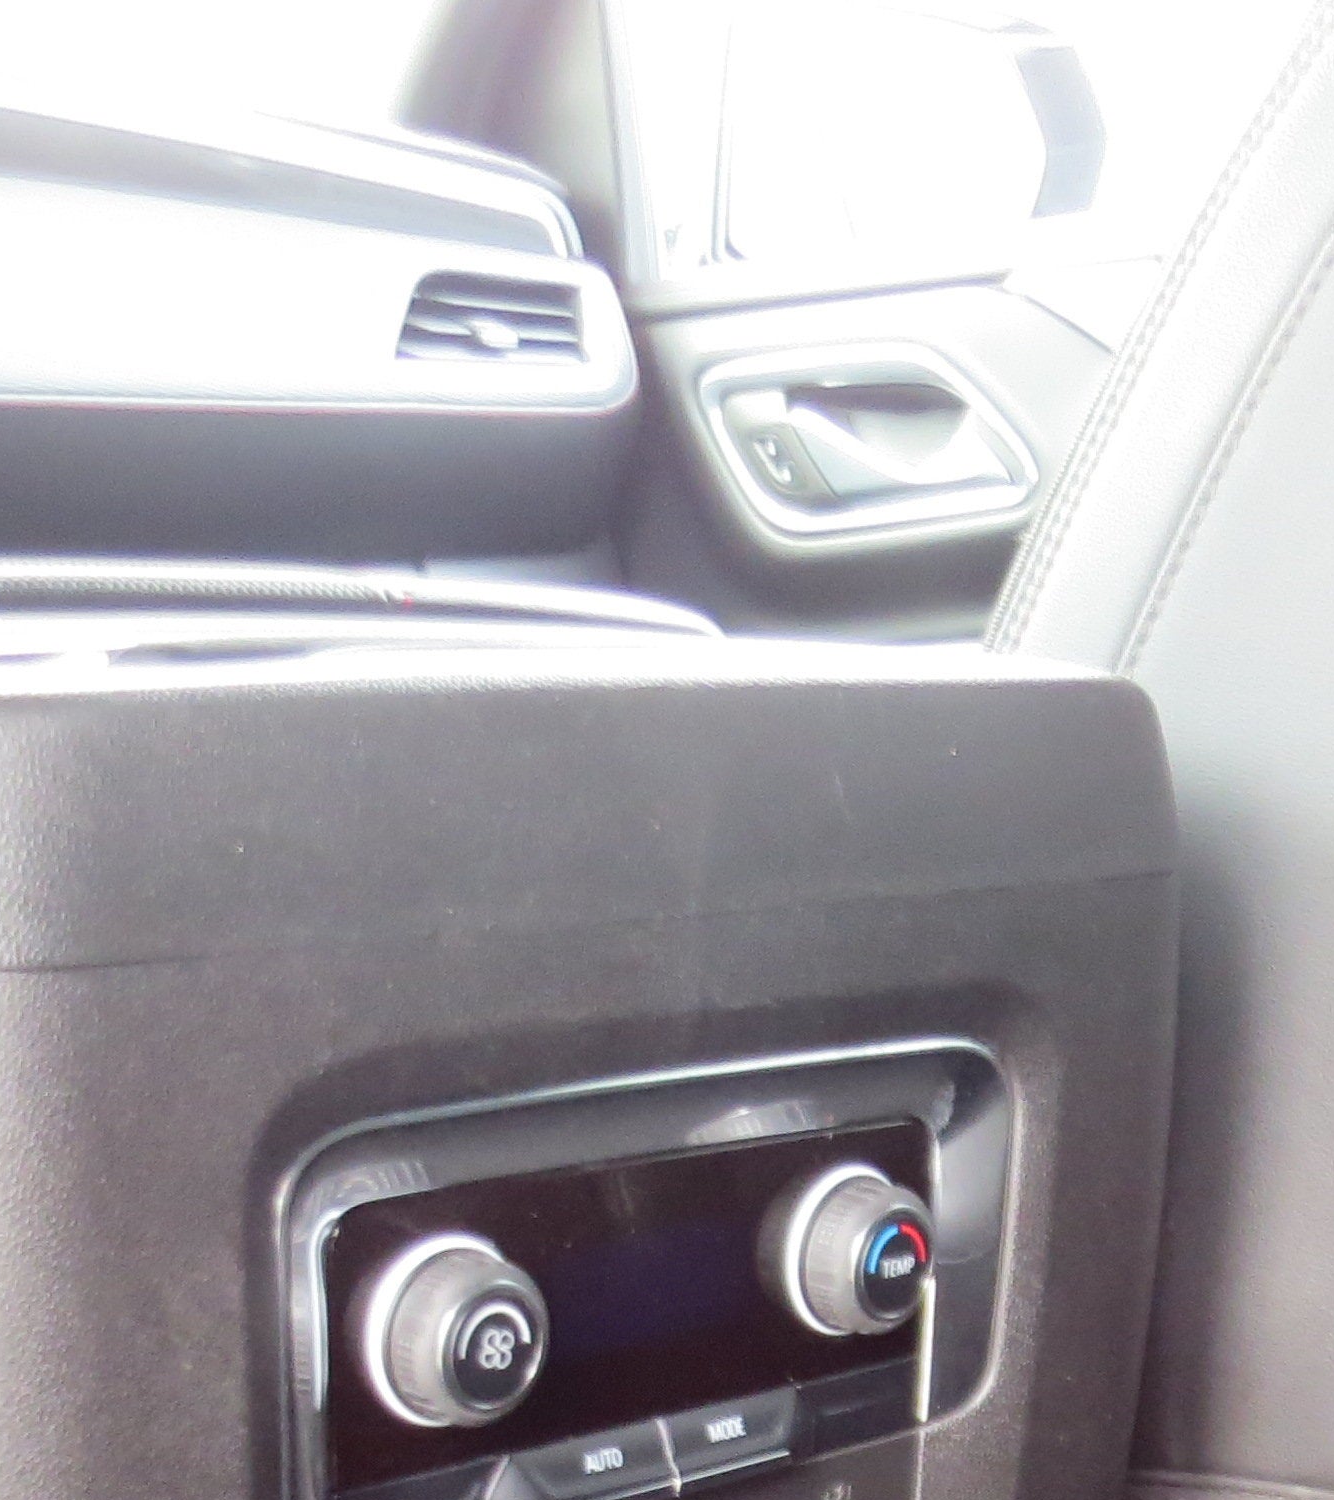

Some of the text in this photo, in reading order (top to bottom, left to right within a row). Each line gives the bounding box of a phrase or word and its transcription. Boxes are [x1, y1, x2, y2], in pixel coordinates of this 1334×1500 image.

[882, 1255, 916, 1279] TEMP
[705, 1415, 747, 1443] MODE
[583, 1447, 624, 1474] AUTO
